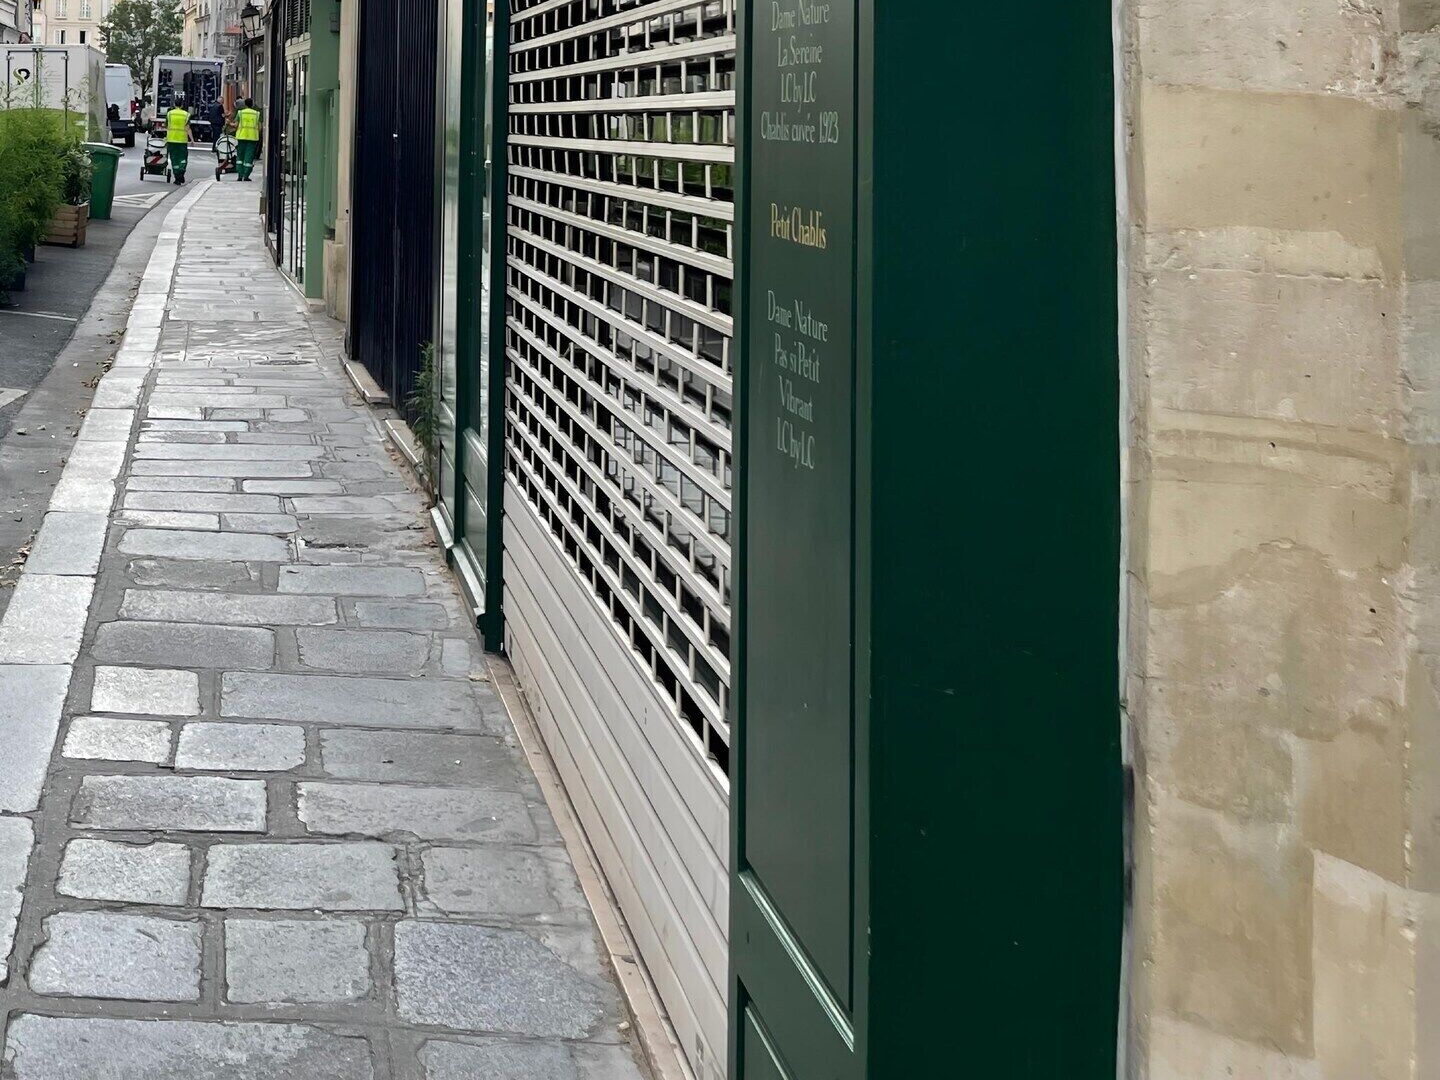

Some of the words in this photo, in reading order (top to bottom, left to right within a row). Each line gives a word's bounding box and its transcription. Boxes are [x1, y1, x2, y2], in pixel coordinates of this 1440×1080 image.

[771, 1, 796, 31] Dame
[777, 37, 788, 67] La
[781, 72, 792, 103] LC
[793, 75, 803, 113] by
[804, 71, 817, 103] LC
[760, 111, 790, 142] Chablis
[791, 113, 815, 143] cuvée
[819, 110, 839, 144] 1923
[771, 203, 791, 241] Petit
[792, 206, 827, 250] Chablis
[767, 290, 792, 329] Dame
[794, 299, 828, 343] Nature
[774, 333, 788, 368] Pas
[789, 342, 797, 374] si
[798, 342, 820, 384] Petit
[778, 375, 813, 423] Vibrant
[777, 416, 790, 453] LC
[790, 428, 801, 469] by
[801, 429, 816, 470] LC
